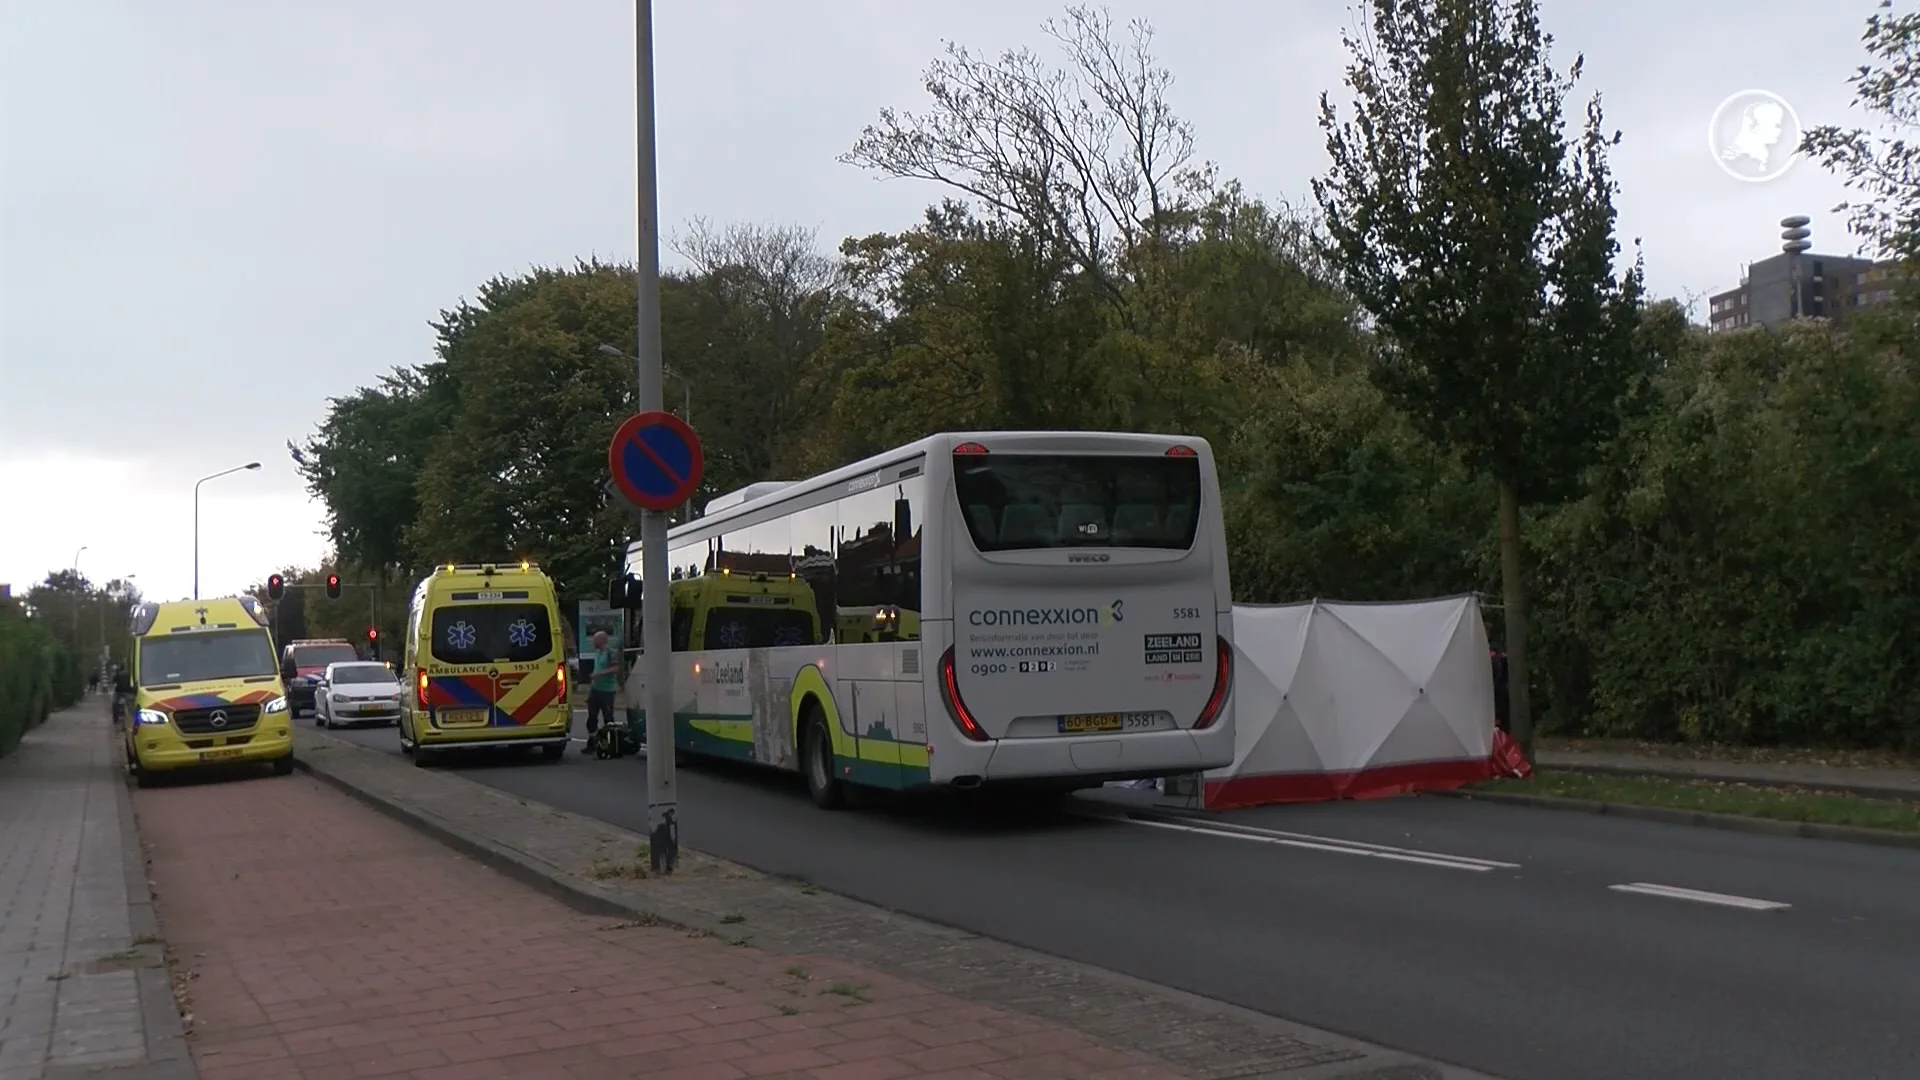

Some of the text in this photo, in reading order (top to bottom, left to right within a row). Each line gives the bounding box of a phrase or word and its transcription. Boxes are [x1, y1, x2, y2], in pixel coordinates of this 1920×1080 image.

[1067, 553, 1110, 563] IVECO
[969, 608, 1099, 626] connexxion
[1173, 608, 1200, 619] 5581
[1067, 632, 1079, 640] tot
[1147, 635, 1200, 648] ZEELAND
[971, 642, 1099, 658] www.connexxion.nl
[1146, 654, 1168, 662] LAND
[429, 664, 540, 675] AMBULANCE 19-134
[971, 663, 1007, 676] 0900
[1020, 661, 1056, 672] 9292
[1127, 713, 1155, 727] 5581
